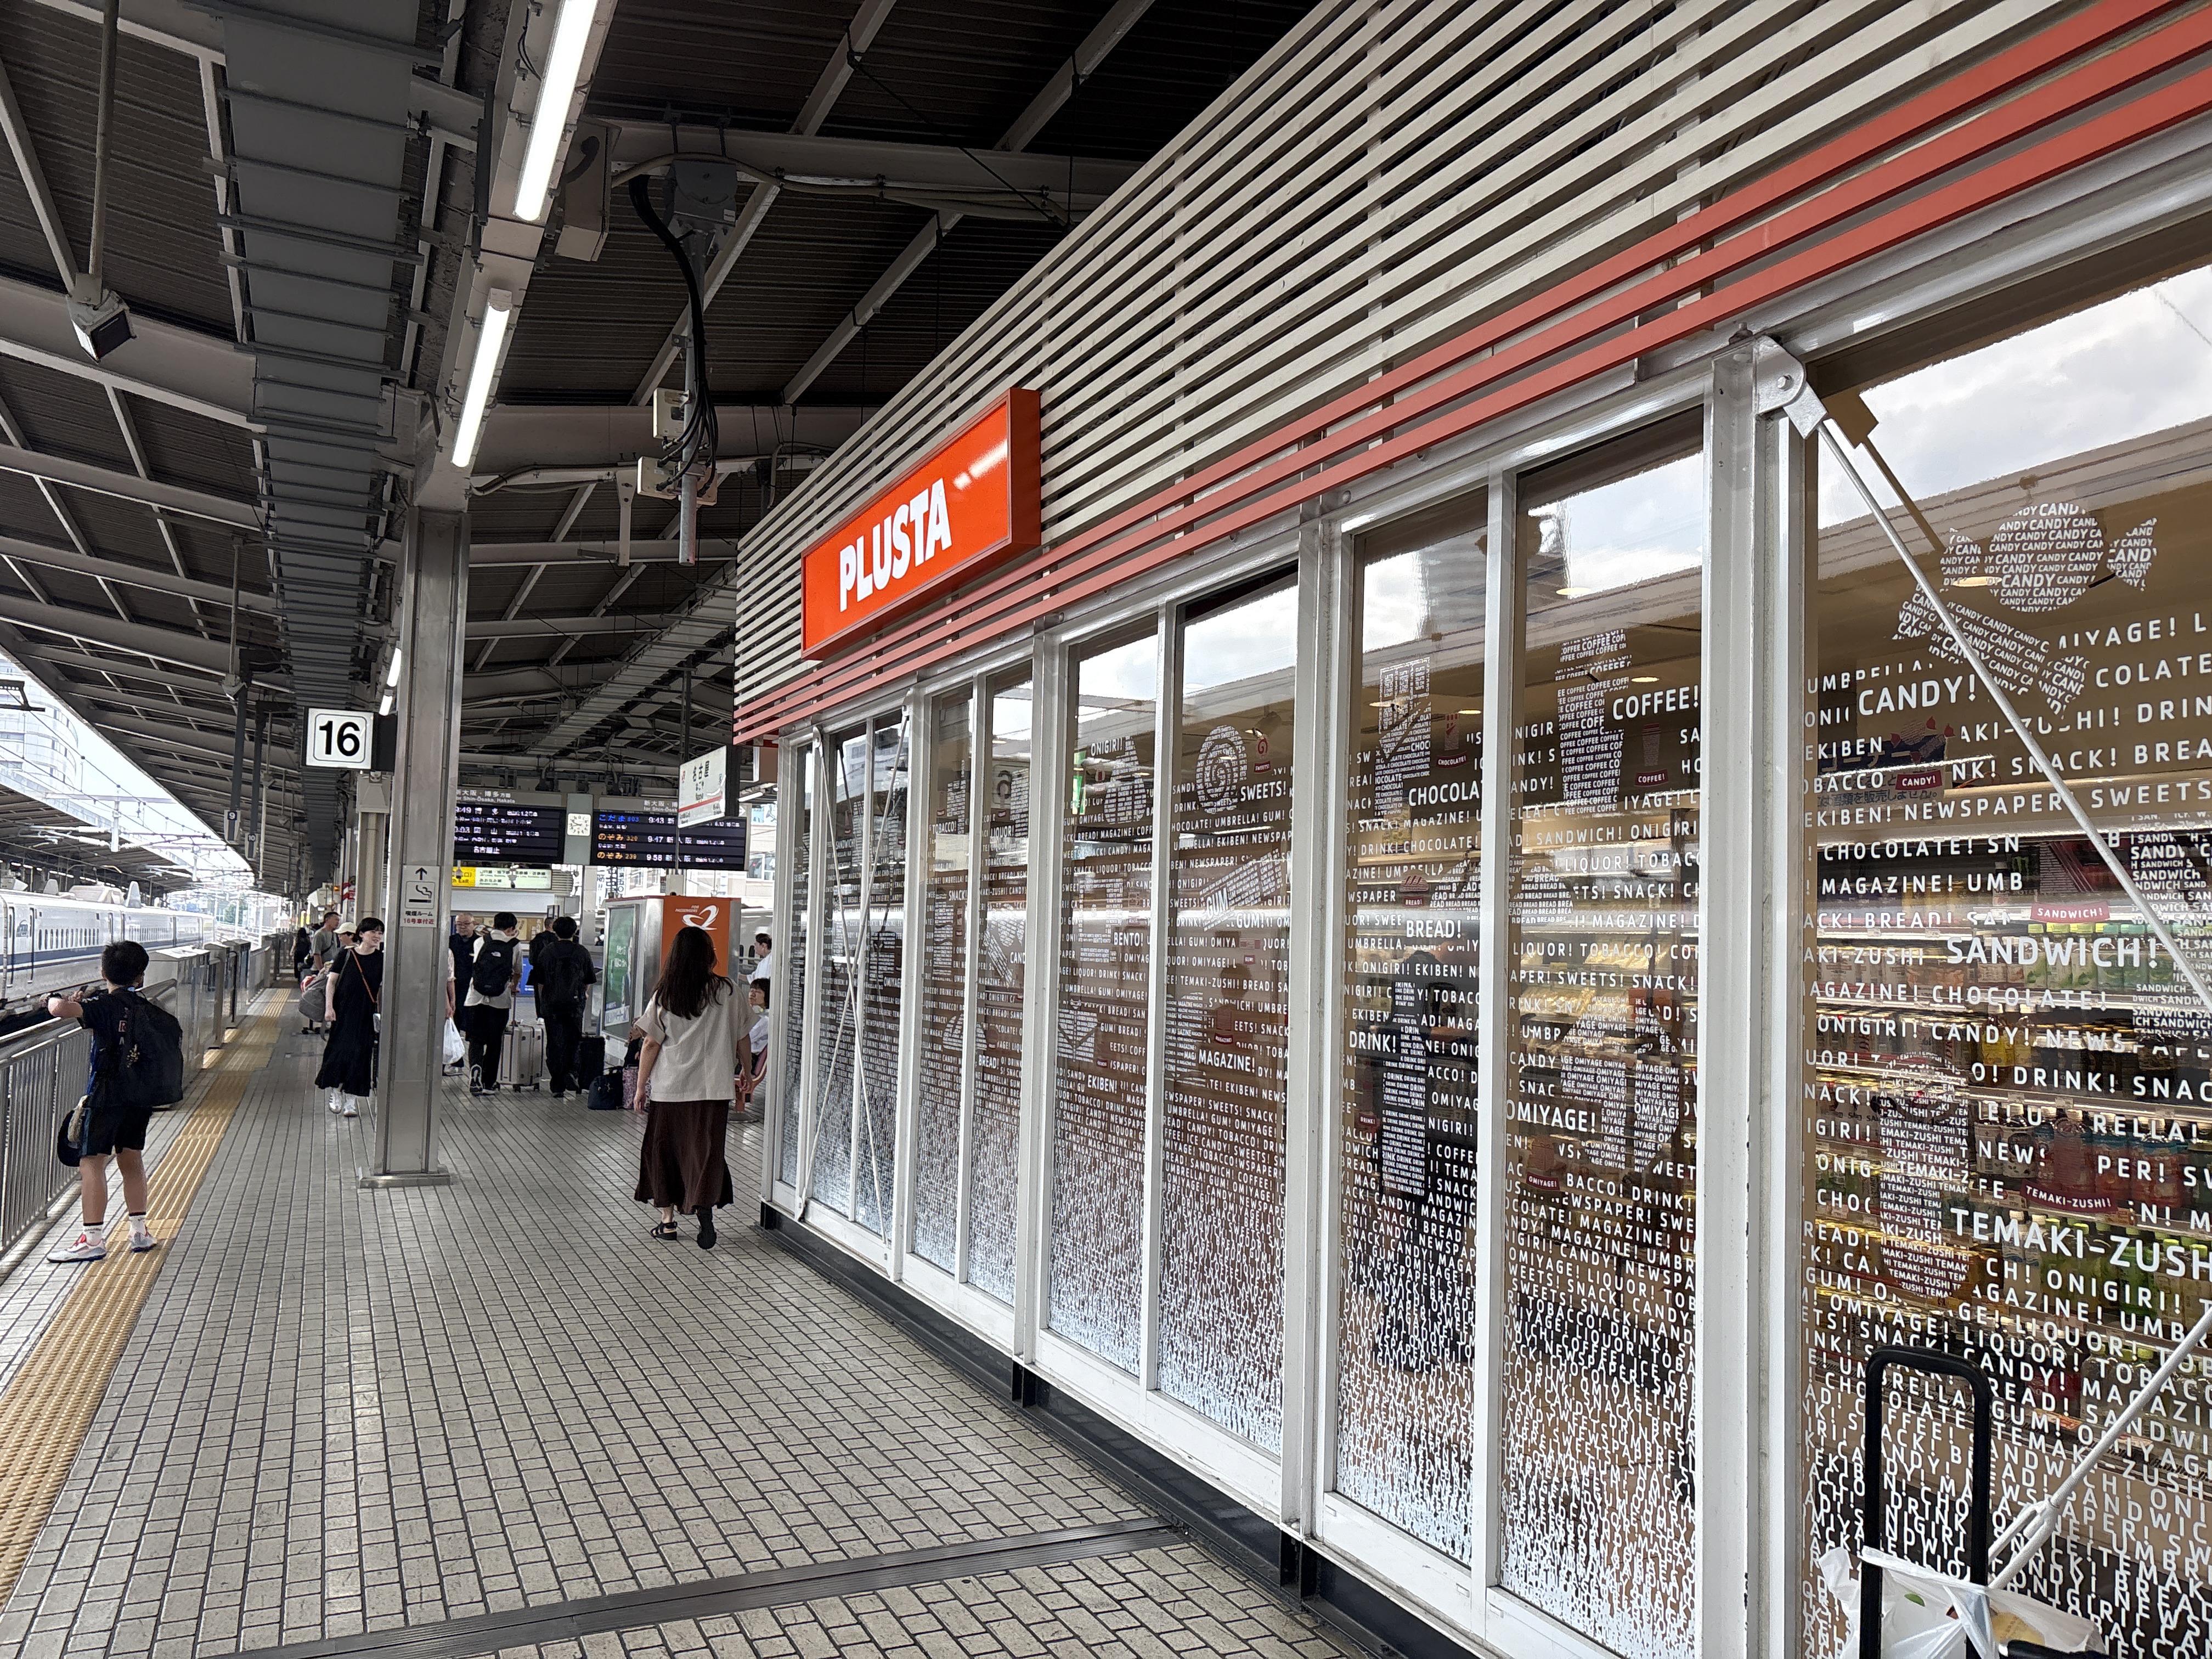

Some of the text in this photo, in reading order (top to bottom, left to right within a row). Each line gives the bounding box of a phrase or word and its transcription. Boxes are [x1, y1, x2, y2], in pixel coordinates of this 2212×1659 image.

[2029, 518, 2071, 529] CANDY
[2015, 529, 2087, 541] CANDY CANDY
[839, 478, 952, 612] PLUSTA
[1989, 540, 2085, 552] CANDY CANDY CANDY
[1995, 551, 2103, 564] CANDY CANDY CANDY
[1582, 636, 1611, 651] COFFEE
[2095, 653, 2212, 688] COLATE
[1566, 681, 1611, 695] COFFEE COFFEE
[1858, 673, 1976, 716] CANDY!
[1612, 685, 1699, 720] COFFEE!
[319, 721, 360, 756] 16
[1091, 738, 1122, 756] ONIGIRI!
[1577, 734, 1620, 747] COFFEE COFFEE
[1805, 736, 1882, 760] EKIBEN
[1438, 756, 1466, 765] CHOCOLATE!
[2012, 748, 2116, 776] SNACK!
[1510, 776, 1554, 793] ANDY!
[1638, 773, 1665, 783] COFFEE!
[1902, 775, 1936, 787] CANDY!
[1240, 781, 1286, 802] SWEETS!
[1409, 780, 1482, 806] CHOCOLA
[1805, 783, 2211, 827] EKIBEN! NEWSPAPER SWEETS
[933, 821, 957, 834] TOBACCO!
[1171, 809, 1285, 832] HOCOLATE! UMBRELLA! GUM!
[1359, 810, 1470, 833] SNACK! MAGAZINE!
[990, 826, 1014, 837] LIQUOR!
[1078, 827, 1135, 840] BREAD! MAGAZINE!
[1537, 820, 1697, 845] SANDWICH! ONIGIRI
[1217, 834, 1248, 848] EKIBEN!
[1361, 836, 1479, 855] DRINK! CHOCOLATE!
[1824, 839, 1973, 861] CHOCOLATE!
[1190, 855, 1238, 868] NEWSPAPER!
[1565, 855, 1630, 873] LIQUOR!
[2141, 860, 2183, 868] SANDWICH
[1614, 883, 1674, 899] SNACK!
[1822, 872, 2023, 895] MAGAZINE! UMB
[949, 890, 967, 901] SNACK!
[1170, 898, 1199, 908] SWEETS!
[1348, 890, 1396, 902] WSPAPER
[1237, 913, 1264, 928] GUM!
[1592, 914, 1685, 928] MAGAZINE!
[2036, 907, 2104, 919] SANDWICH!
[1406, 920, 1462, 939] BREAD!
[1114, 932, 1143, 946] BENTO!
[1189, 936, 1207, 947] GUM!
[1011, 952, 1025, 964] CAND
[1513, 942, 1661, 959] LIQUOR! TOBACCO!
[1804, 947, 1923, 965] AKI-ZUSHI
[1947, 936, 2158, 969] SANDWICH!
[1192, 956, 1229, 968] OMIYAGE!
[1363, 962, 1462, 977] ONIGIRI! EKIBEN!
[1073, 967, 1146, 981] LIQUOR! DRINK! SNACK!
[1558, 970, 1694, 990] SWEETS! SNACK!
[1181, 975, 1274, 992] TEMAKI-ZUSHI! BREAD!
[2137, 984, 2186, 993] SANDWICH
[1098, 986, 1114, 996] GUM!
[1116, 988, 1147, 1000] OMIYAGE!
[1932, 985, 2107, 1012] CHOCOLATE!
[1352, 1008, 1389, 1020] EKIBEN
[1818, 1015, 2030, 1046] ONIGIRI! CANDY!
[1350, 1031, 1396, 1053] DRINK!
[979, 1054, 999, 1069] BREAD!
[1199, 1049, 1255, 1073] MAGAZINE!
[1575, 1058, 1602, 1068] OMIYAGE
[1088, 1074, 1118, 1094] EKIBEN!
[2014, 1065, 2116, 1094] DRINK!
[1506, 1099, 1596, 1134] OMIYAGE!
[1429, 1117, 1473, 1137] NIGIRI!
[1904, 1121, 1955, 1135] TEMAKI-ZUSHI
[2094, 1113, 2198, 1145] RELLA!
[1895, 1139, 1954, 1155] TEMAKI-ZUSHI
[1528, 1176, 1556, 1187] OMIYAGE!
[1887, 1183, 1940, 1198] TEMAKI-ZUSHI
[1566, 1173, 1691, 1211] BACCO! DRINK!
[2025, 1186, 2112, 1209] TEMAKI-ZUSHI!
[1375, 1192, 1415, 1215] CANDY!
[1377, 1208, 1467, 1243] SNACK! BREAD!
[1579, 1215, 1671, 1247] MAGAZINE!
[1551, 1226, 1638, 1259] MAGAZINE!
[1804, 1221, 1870, 1250] READ!
[1950, 1207, 2212, 1281] TEMAKI-ZUSH
[1806, 1266, 1861, 1295] GUM!
[2047, 1269, 2181, 1314] ONIGIRI!
[1830, 1296, 1949, 1334] OMIYAGE!
[2016, 1314, 2138, 1362] LIQUOR!
[1964, 1325, 2079, 1372] LIQUOR!
[1992, 1400, 2061, 1437] GUM!
